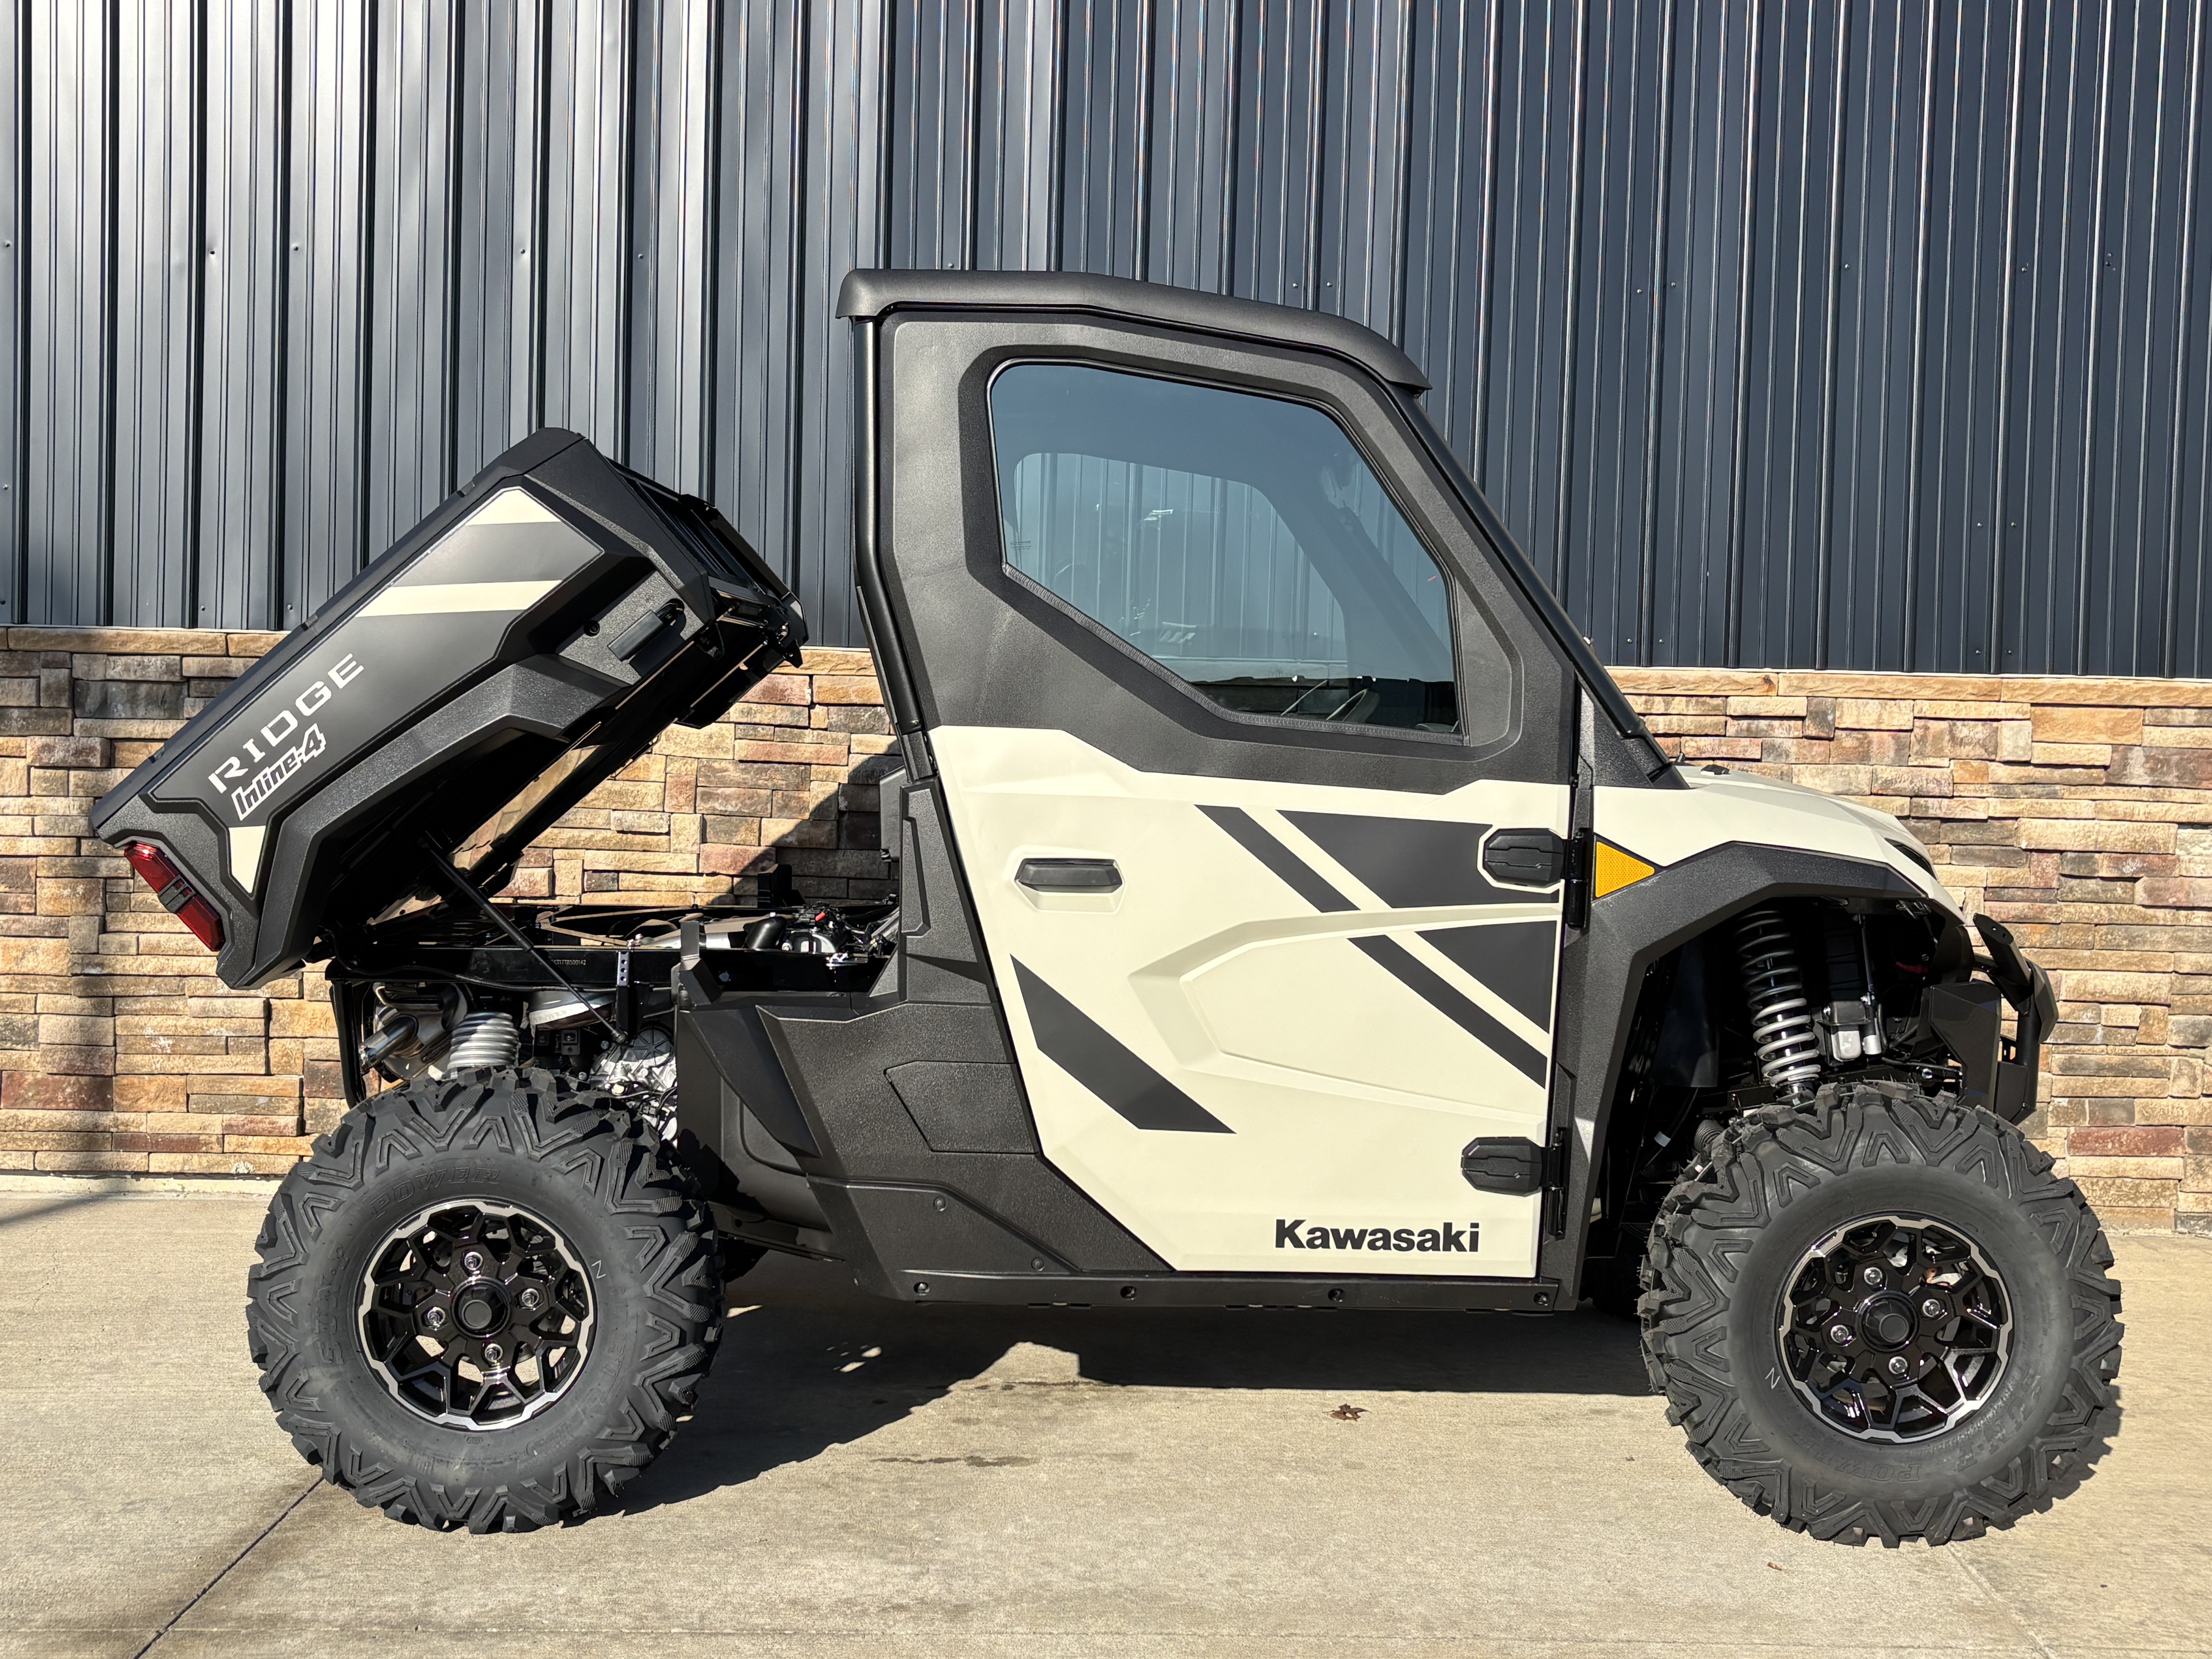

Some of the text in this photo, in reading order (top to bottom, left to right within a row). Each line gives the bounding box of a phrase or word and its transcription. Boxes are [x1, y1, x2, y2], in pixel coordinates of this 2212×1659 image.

[208, 653, 364, 793] RIDGE
[231, 723, 326, 821] Inline-4
[369, 1167, 501, 1219] POWER
[1275, 1219, 1479, 1252] Kawasaki
[1788, 1432, 1922, 1483] POWER
